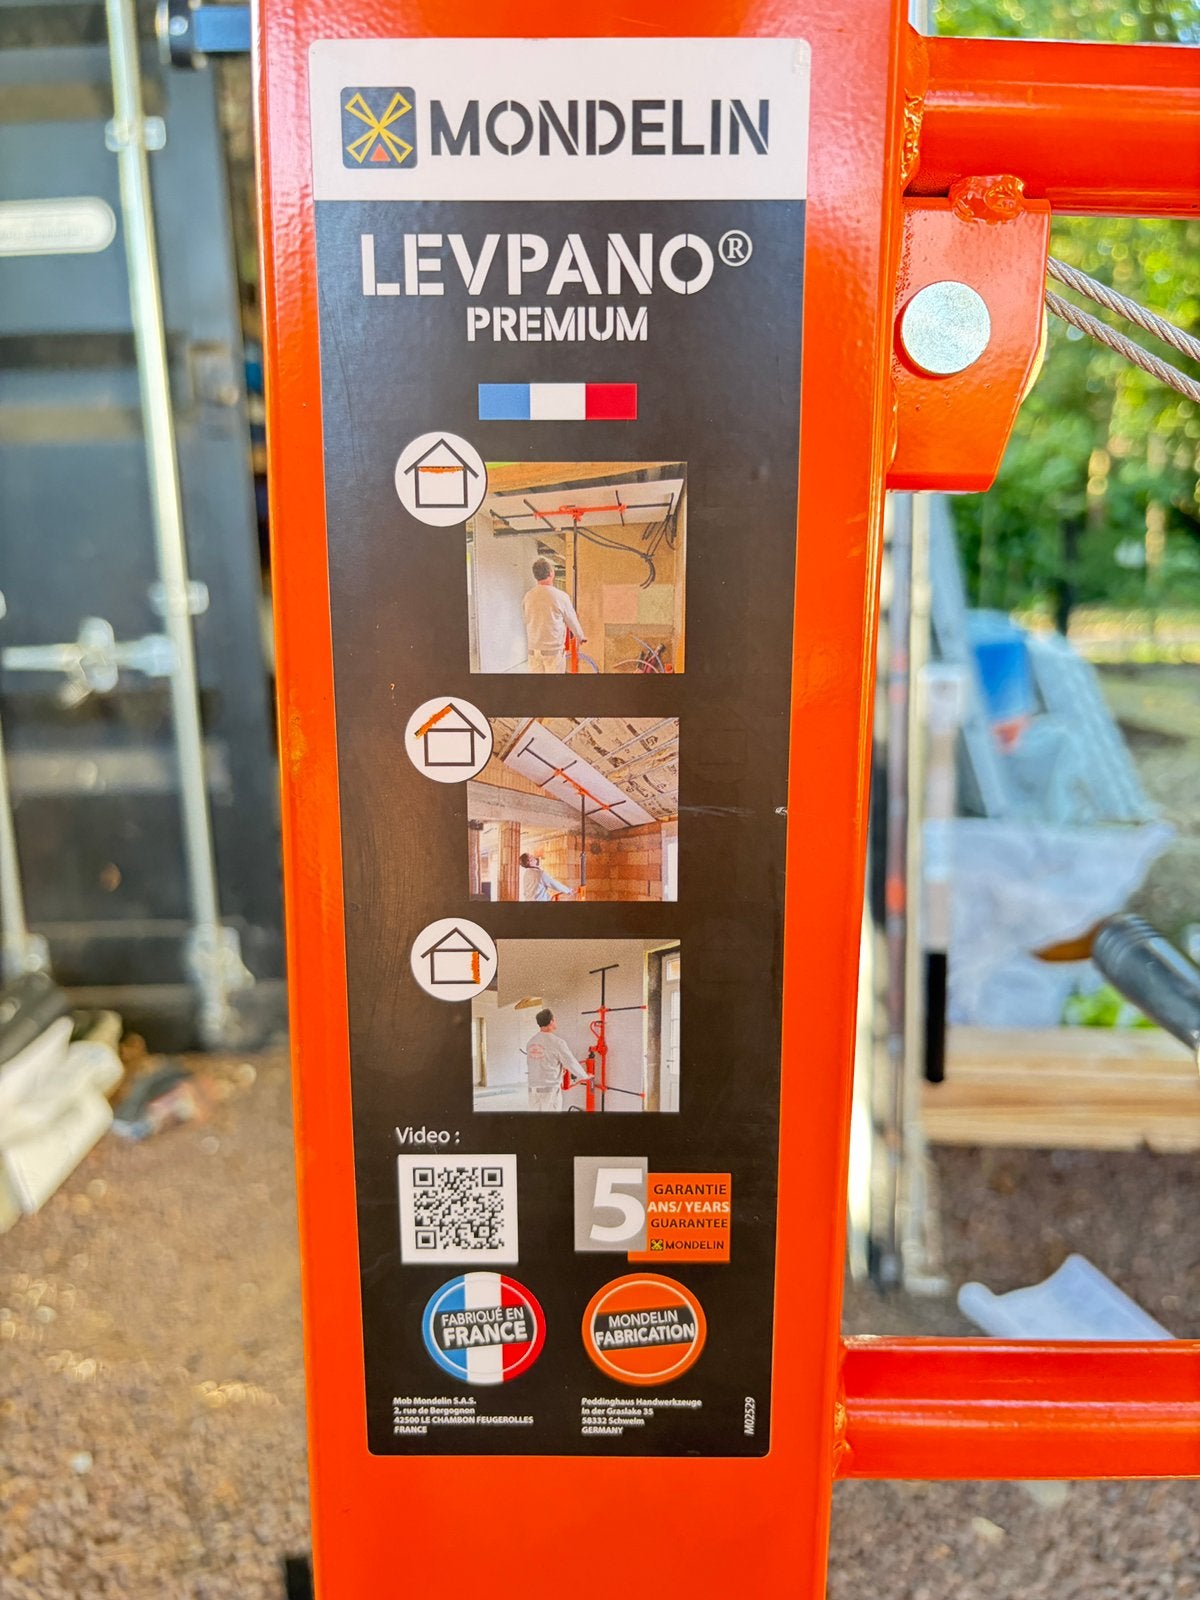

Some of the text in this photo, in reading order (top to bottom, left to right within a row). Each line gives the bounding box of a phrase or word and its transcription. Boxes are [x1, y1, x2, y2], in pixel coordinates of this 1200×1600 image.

[430, 99, 770, 156] MONDELIN
[466, 306, 649, 342] PREMIUM
[395, 1125, 451, 1144] Video
[653, 1184, 727, 1195] GARANTIE
[589, 1167, 646, 1242] 5
[647, 1201, 730, 1213] ANS/ YEARS
[650, 1218, 728, 1229] GUARANTEE
[665, 1240, 725, 1250] MONDELIN
[441, 1306, 525, 1327] FABRIQUÉ EN
[608, 1309, 679, 1329] MONDELIN
[442, 1320, 528, 1349] FRANCE
[595, 1322, 695, 1346] FABRICATION
[393, 1397, 477, 1405] Mob Mondelin S.A.S.
[581, 1397, 703, 1409] Peddinghaus Handwerkzeuge
[418, 1407, 429, 1415] de
[430, 1407, 475, 1416] Bergognon
[591, 1407, 605, 1415] der
[744, 1396, 756, 1436] M02529
[394, 1416, 534, 1425] 42500 LE CHAMBON FEUGEROLLES
[394, 1426, 428, 1434] FRANCE
[581, 1426, 624, 1435] GERMANY
